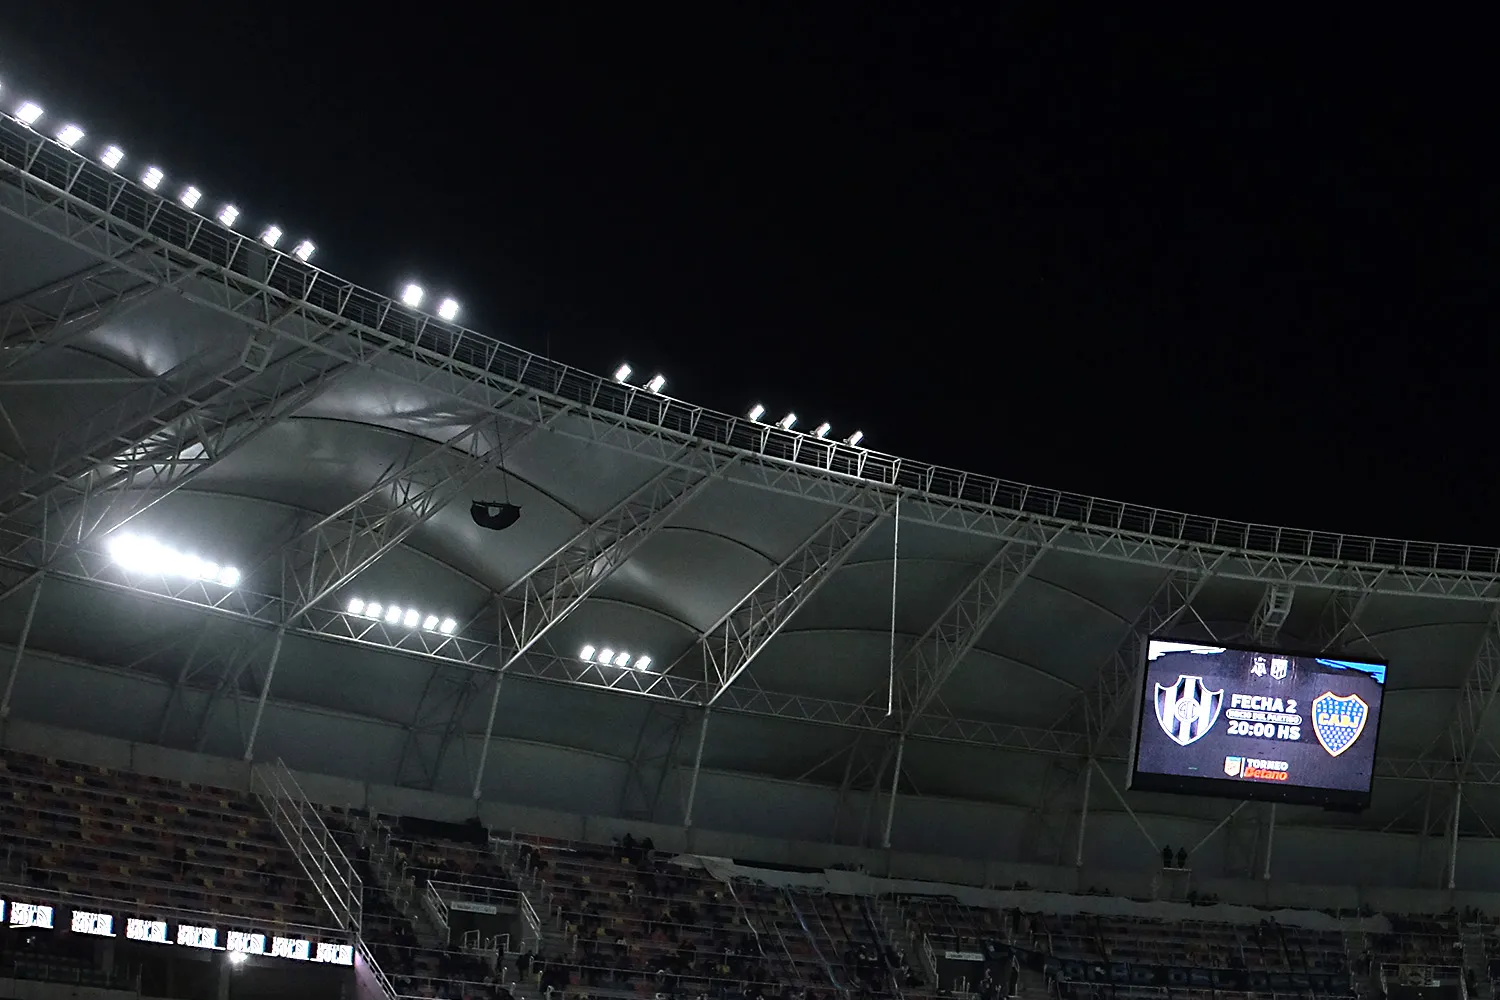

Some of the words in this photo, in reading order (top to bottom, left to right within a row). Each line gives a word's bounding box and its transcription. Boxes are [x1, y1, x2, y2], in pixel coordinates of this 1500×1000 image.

[1231, 693, 1284, 713] FECHA
[1285, 699, 1298, 714] 2
[1227, 720, 1276, 738] 20:00
[1277, 725, 1301, 740] HS
[1246, 758, 1289, 771] TORNEO
[1244, 767, 1289, 780] Betano
